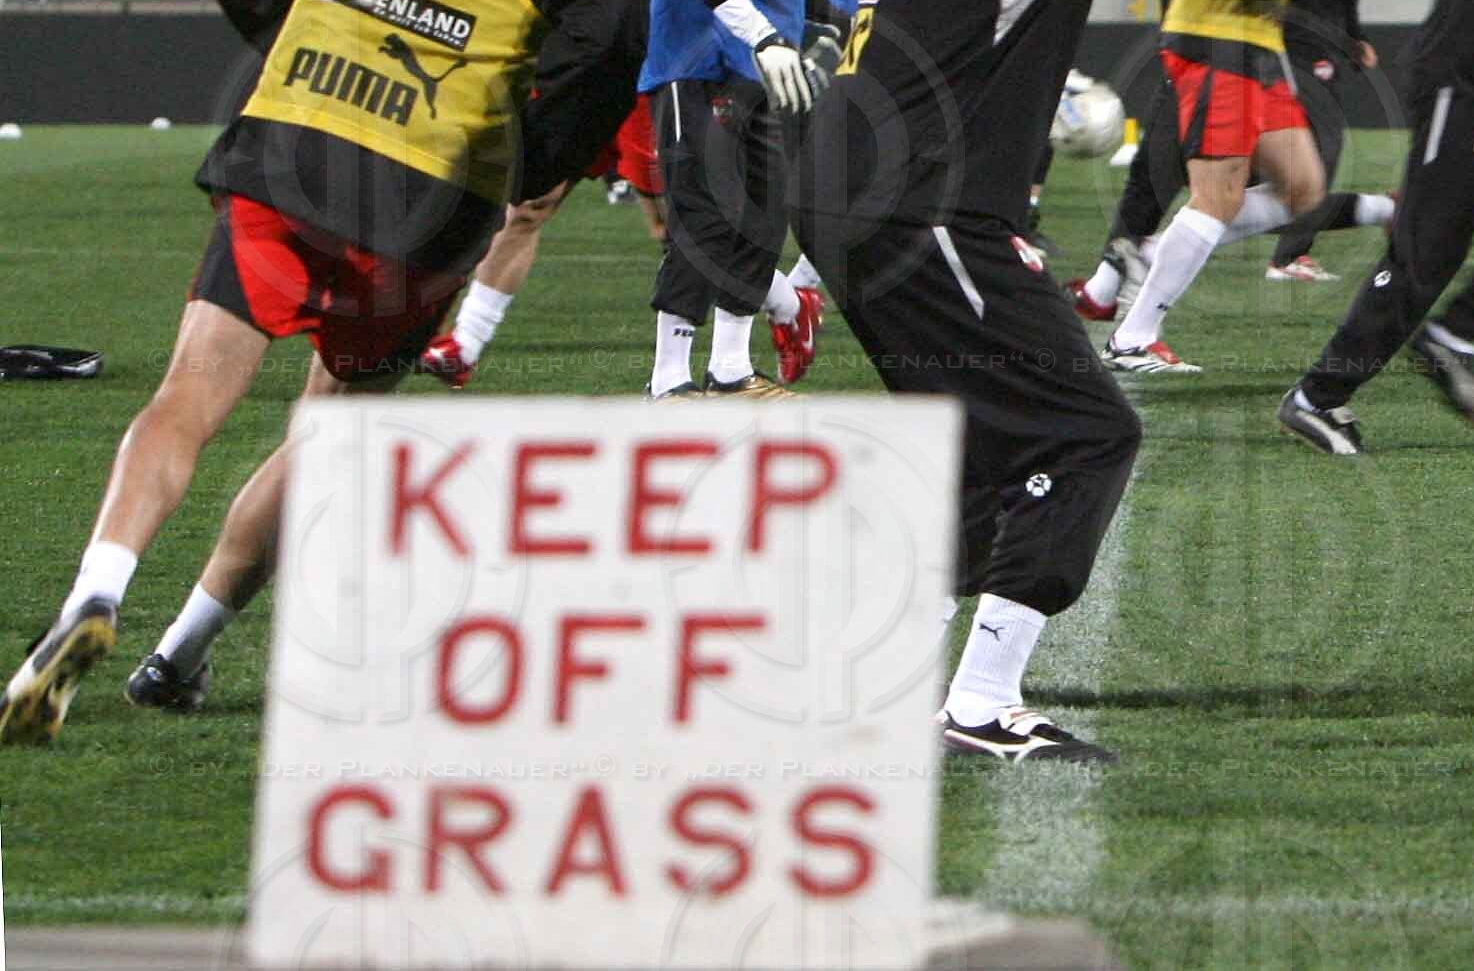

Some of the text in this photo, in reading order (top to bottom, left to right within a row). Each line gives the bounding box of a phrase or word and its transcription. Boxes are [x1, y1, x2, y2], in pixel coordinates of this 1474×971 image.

[283, 47, 418, 128] PUMA
[386, 439, 841, 558] KEEP
[434, 614, 768, 726] OFF
[305, 784, 880, 898] GRASS
